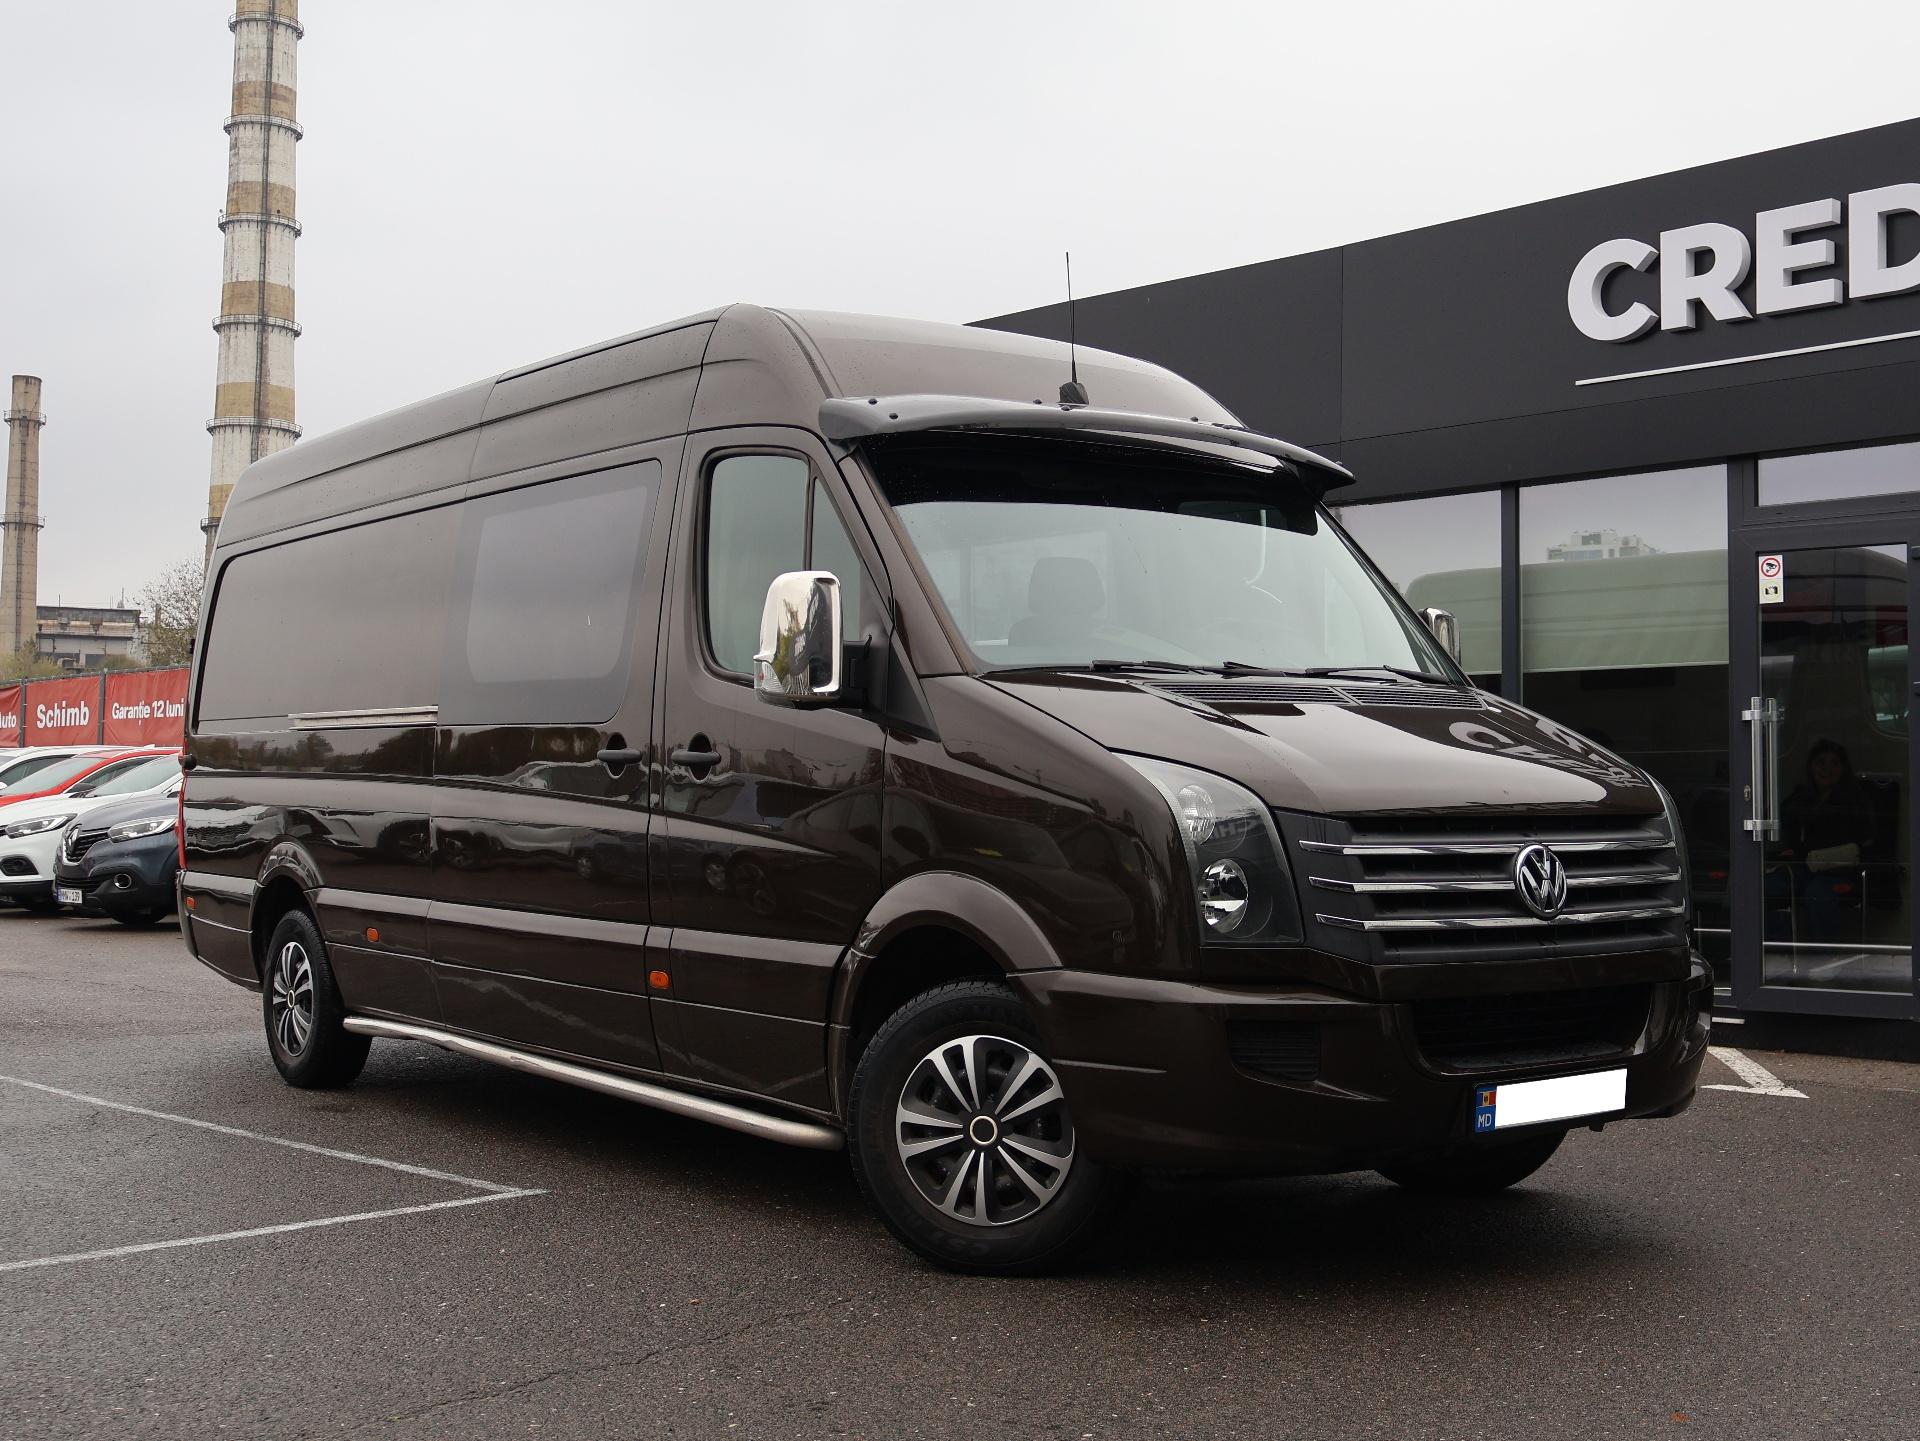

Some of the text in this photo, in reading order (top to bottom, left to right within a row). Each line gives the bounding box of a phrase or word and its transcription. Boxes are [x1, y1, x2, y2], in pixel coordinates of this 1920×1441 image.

[36, 701, 90, 729] Schimb
[152, 700, 165, 718] 12
[166, 697, 184, 718] luni
[0, 711, 17, 729] uto
[1477, 1113, 1492, 1128] MD
